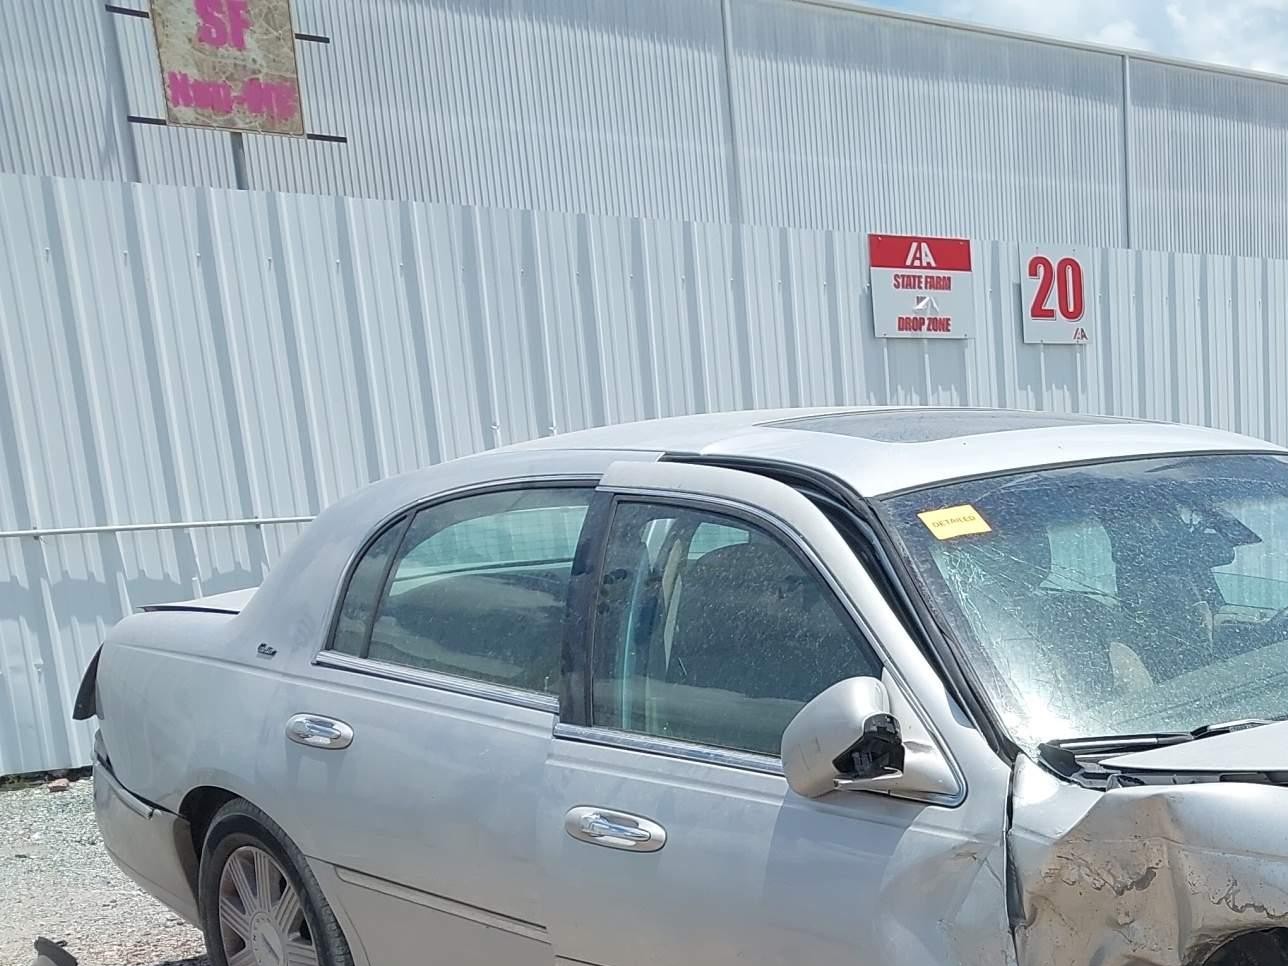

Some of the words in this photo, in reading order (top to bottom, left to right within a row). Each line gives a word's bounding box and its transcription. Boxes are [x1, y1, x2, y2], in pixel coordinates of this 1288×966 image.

[893, 273, 923, 290] STATE
[924, 275, 951, 291] FARM
[1028, 255, 1085, 322] 20
[897, 316, 925, 331] DROP
[926, 317, 951, 332] ZONE
